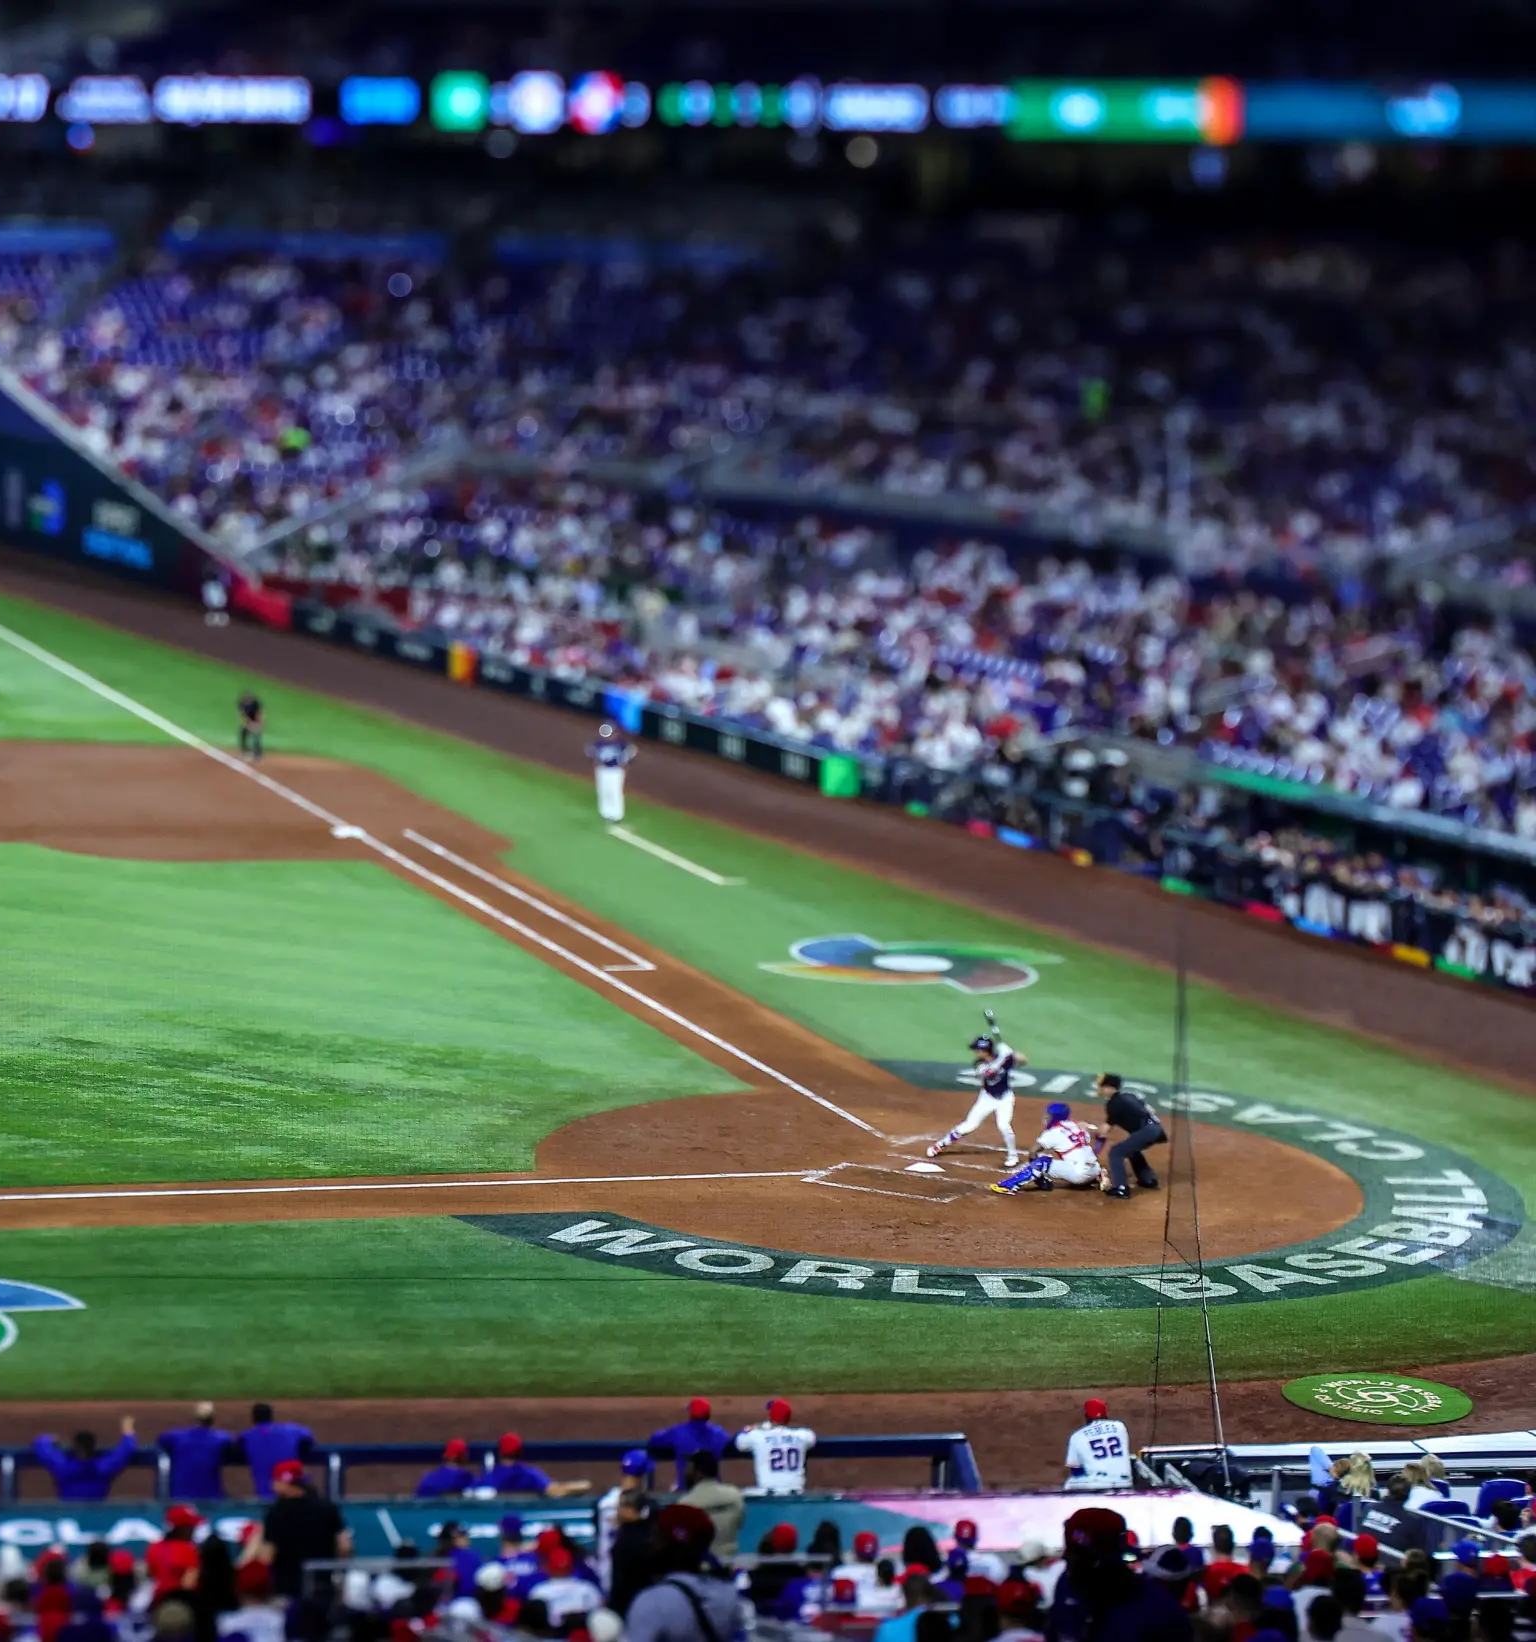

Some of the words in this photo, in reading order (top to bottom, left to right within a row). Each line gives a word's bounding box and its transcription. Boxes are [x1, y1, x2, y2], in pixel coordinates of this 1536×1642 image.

[955, 1067, 1425, 1162] CLASSIC
[1132, 1169, 1490, 1300] BASEBALL
[547, 1219, 1071, 1301] WORLD
[1321, 1379, 1393, 1388] WORLD
[1314, 1394, 1383, 1415] CLASSIC
[770, 1448, 800, 1472] 20
[1089, 1436, 1123, 1461] 52
